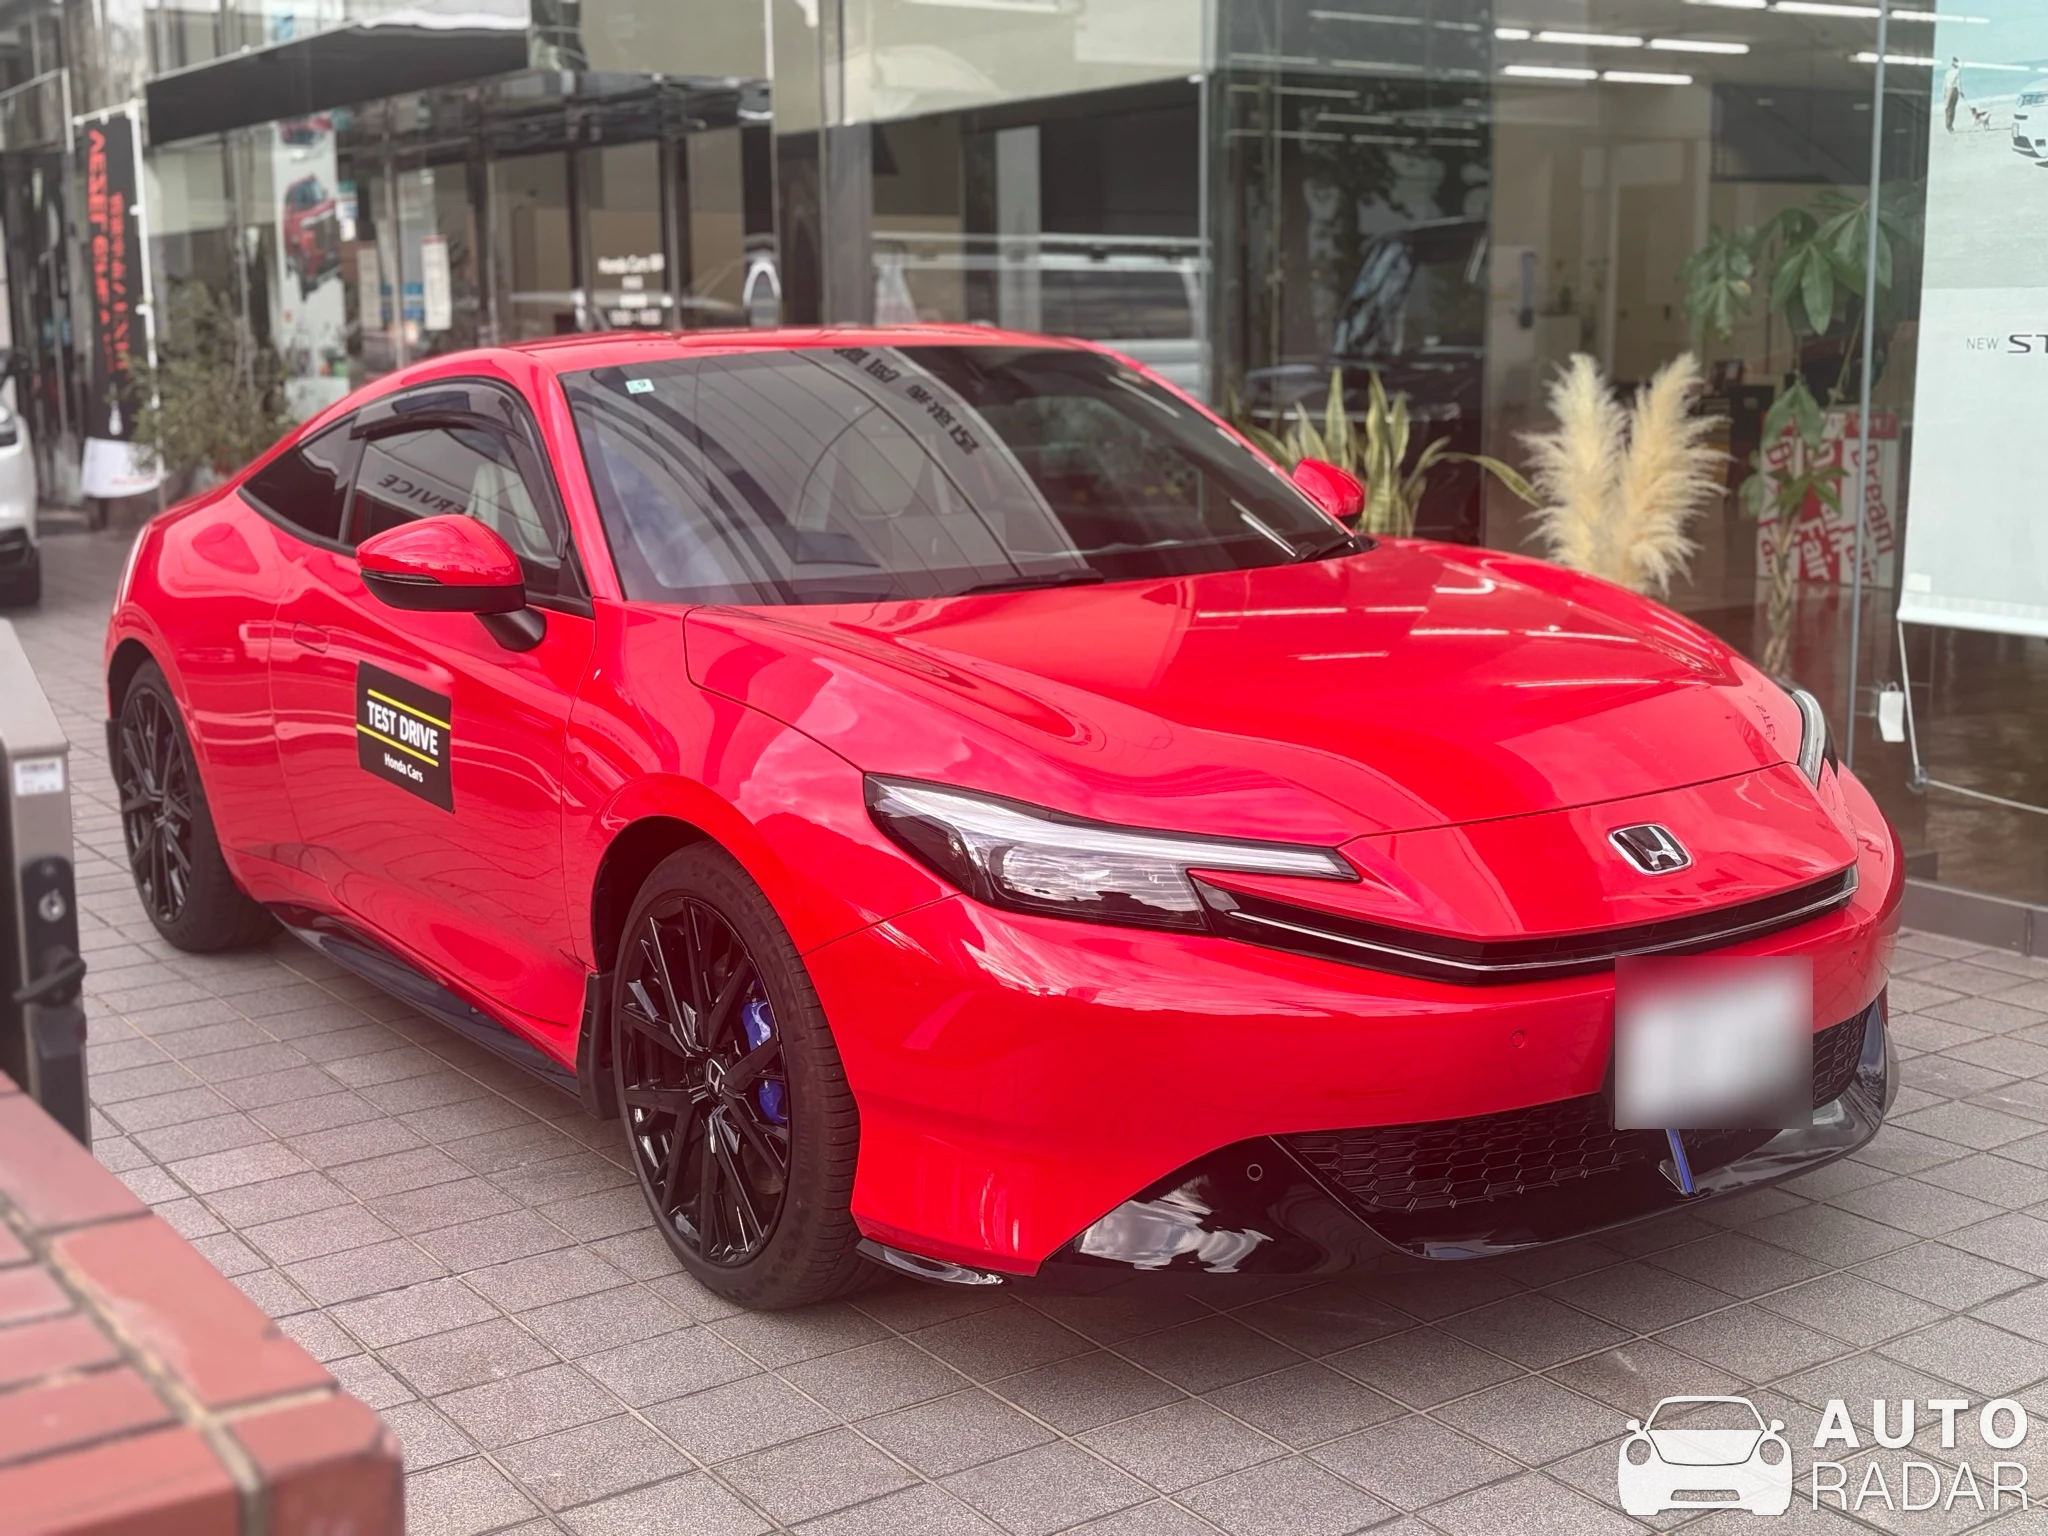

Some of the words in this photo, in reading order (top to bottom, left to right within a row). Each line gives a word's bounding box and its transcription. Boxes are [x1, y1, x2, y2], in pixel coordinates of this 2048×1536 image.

[1966, 337, 1999, 350] NEW
[366, 700, 397, 735] TEST
[399, 715, 439, 756] DRIVE
[384, 752, 406, 775] Honda
[407, 764, 424, 783] Cars
